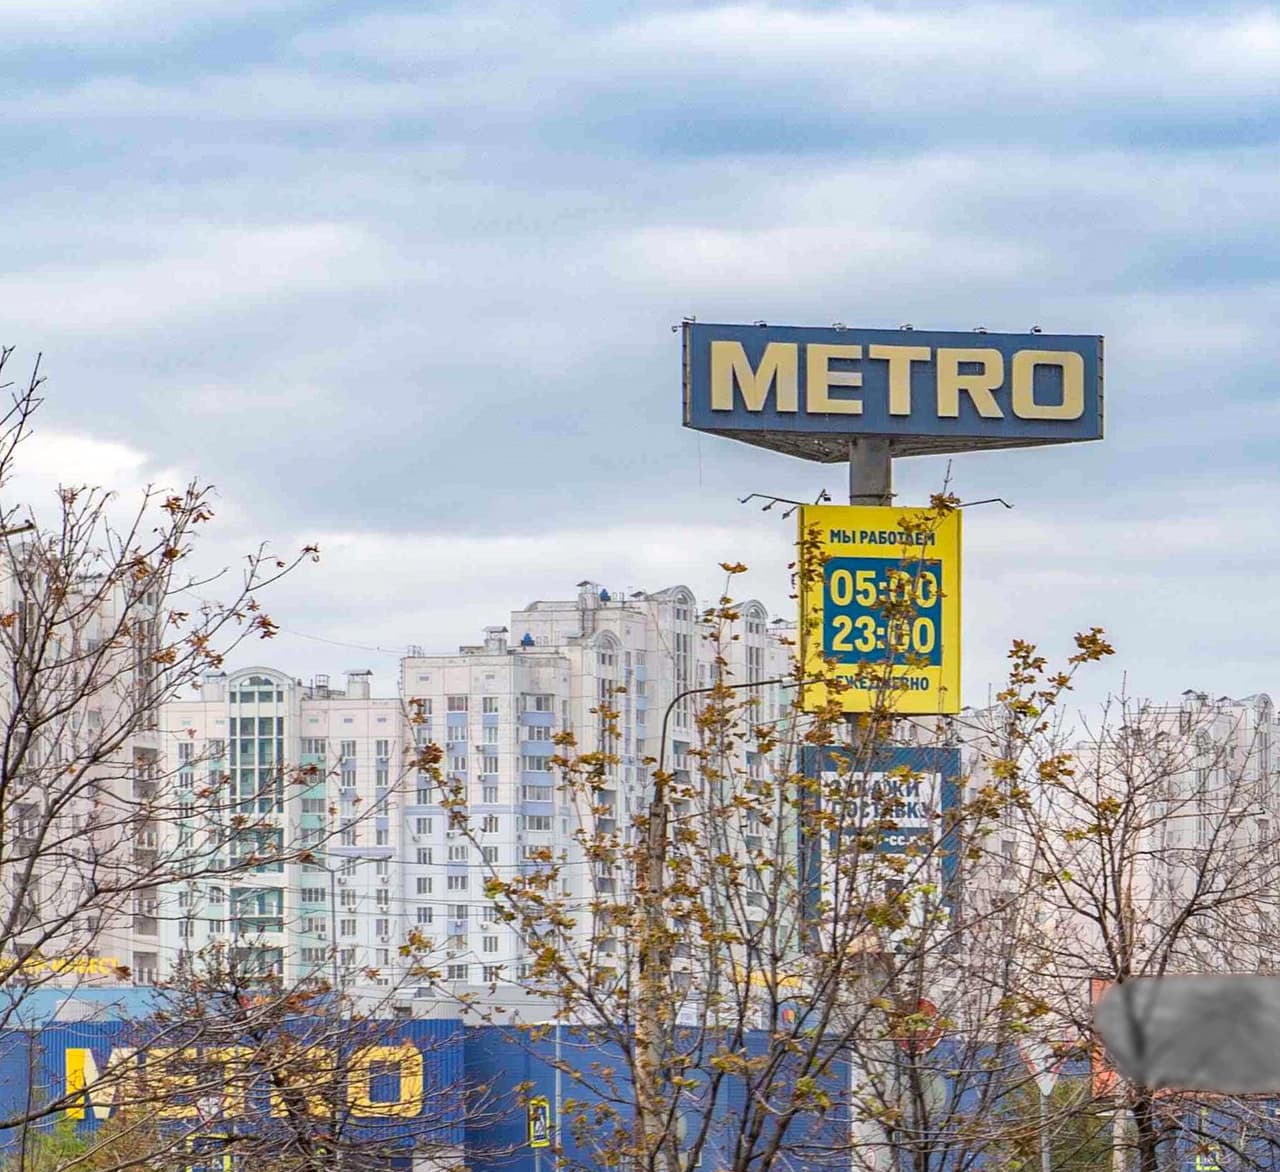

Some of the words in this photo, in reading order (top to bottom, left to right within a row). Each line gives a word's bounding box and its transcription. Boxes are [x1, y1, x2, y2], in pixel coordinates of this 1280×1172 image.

[710, 340, 1085, 422] METRO
[830, 530, 855, 543] МЫ
[830, 569, 937, 608] 05:00
[832, 615, 935, 653] 23:00
